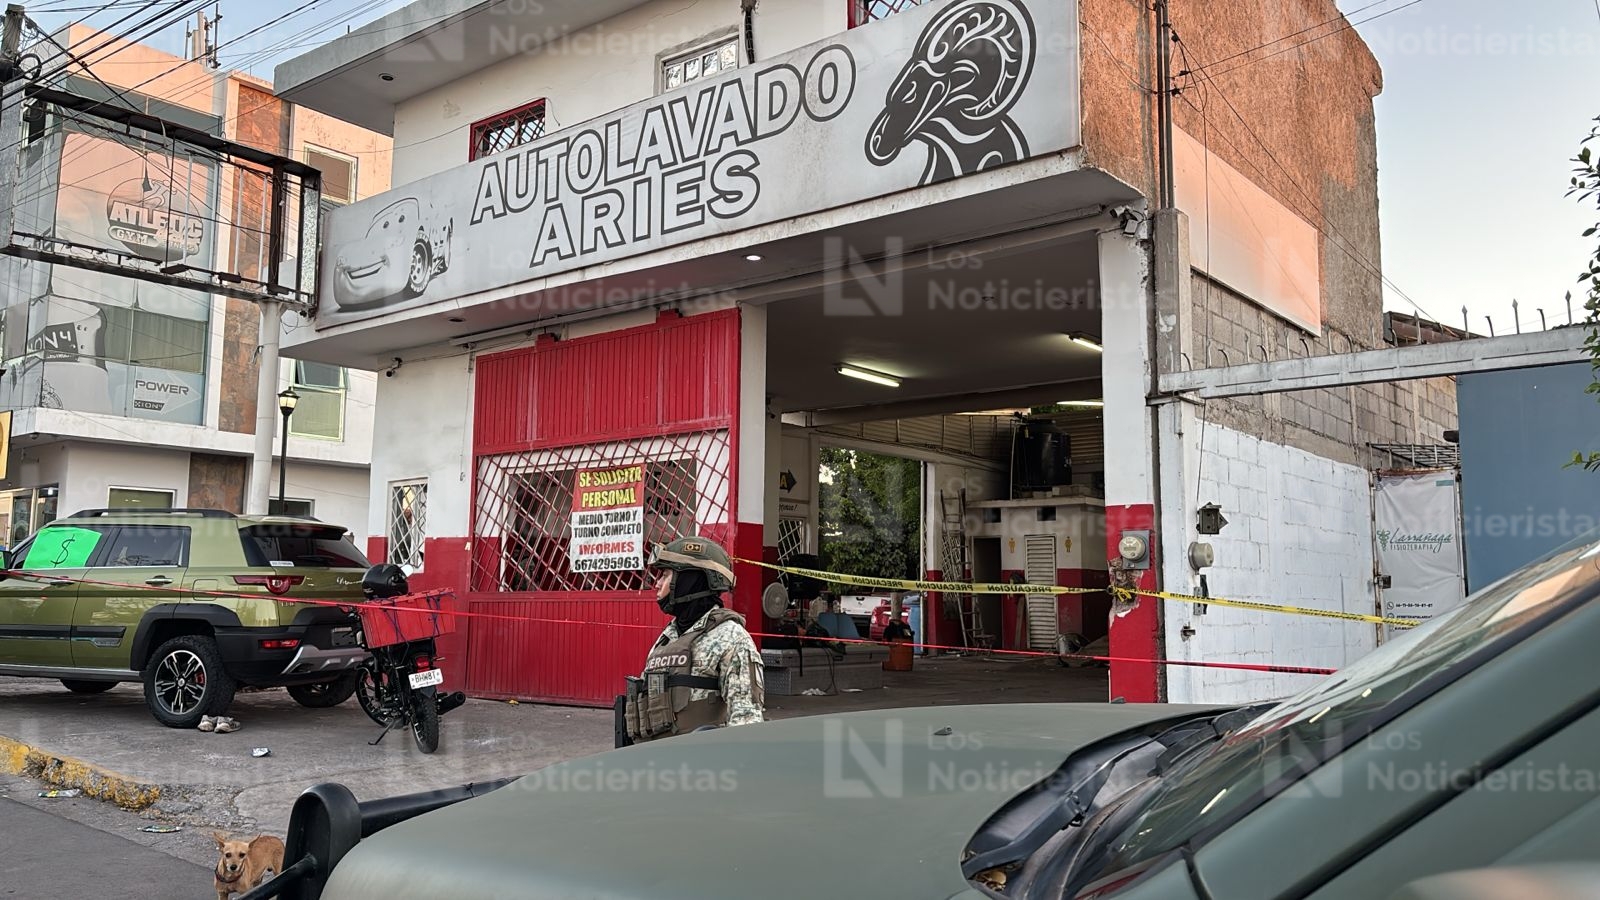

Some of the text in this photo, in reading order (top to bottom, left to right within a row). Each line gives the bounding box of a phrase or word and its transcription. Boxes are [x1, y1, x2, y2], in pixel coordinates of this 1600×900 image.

[469, 43, 857, 226] AUTOLAVADO
[529, 148, 761, 268] ARIES
[116, 229, 149, 245] GYM
[135, 379, 190, 396] POWER
[593, 466, 642, 486] SOLICITA
[582, 487, 636, 508] PERSONAL
[578, 512, 603, 526] MEDIO
[631, 510, 638, 521] Y
[574, 523, 641, 538] TURNO COMPLETO
[578, 541, 635, 556] INFORMES
[1390, 527, 1454, 554] Larrañaga
[1390, 543, 1433, 551] FISIOTERAPIA
